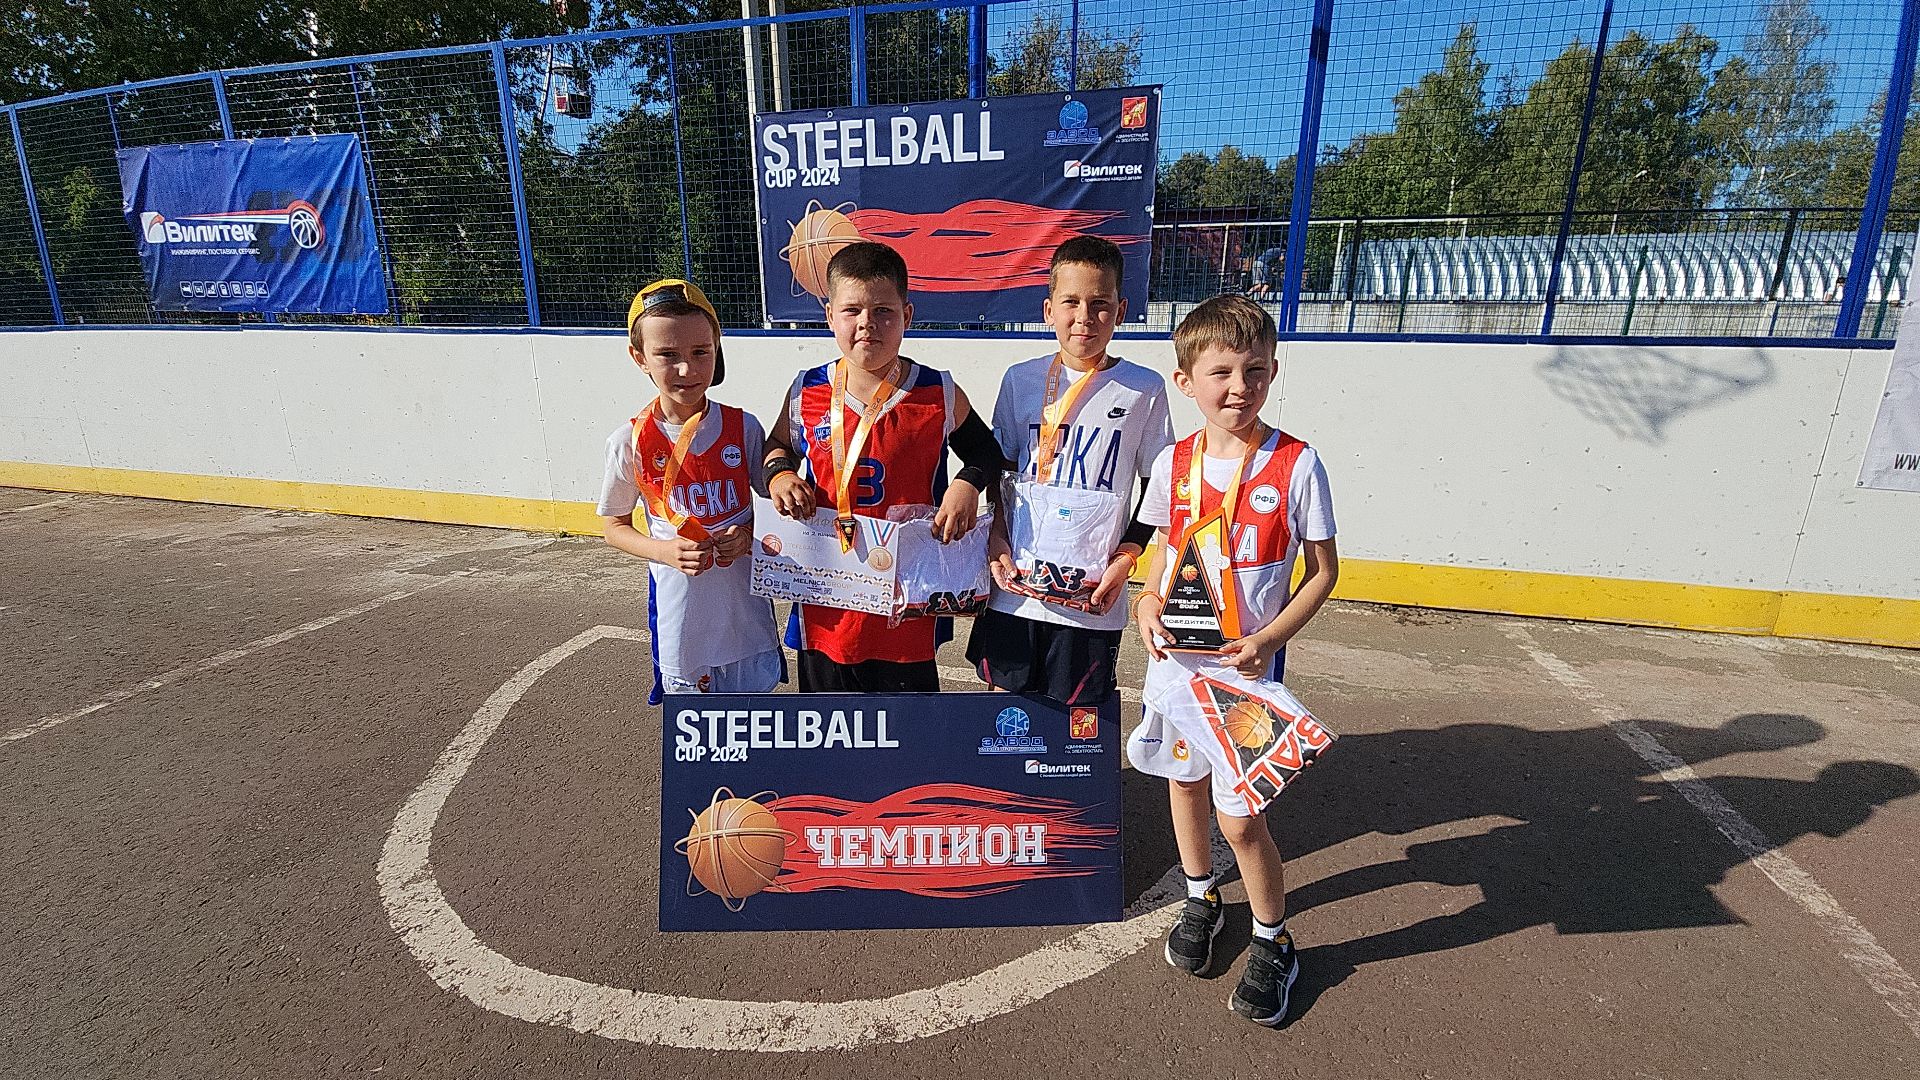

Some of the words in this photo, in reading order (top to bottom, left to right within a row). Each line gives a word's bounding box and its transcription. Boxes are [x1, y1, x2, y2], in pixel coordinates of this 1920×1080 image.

[763, 111, 1005, 171] STEELBALL
[765, 168, 797, 188] CUP
[801, 165, 841, 187] 2024
[1081, 164, 1143, 177] Вилитек
[164, 221, 258, 243] Вилитек
[856, 457, 886, 507] 3
[1254, 494, 1276, 504] РФБ
[1163, 618, 1216, 626] ПОБЕДИТЕЛЬ
[675, 709, 900, 749] STEELBALL
[981, 736, 1044, 747] ЗАВОД
[675, 745, 706, 762] CUP
[710, 745, 748, 762] 2024
[1039, 763, 1091, 773] Вилитек
[804, 823, 1048, 869] ЧЕМПИОН
